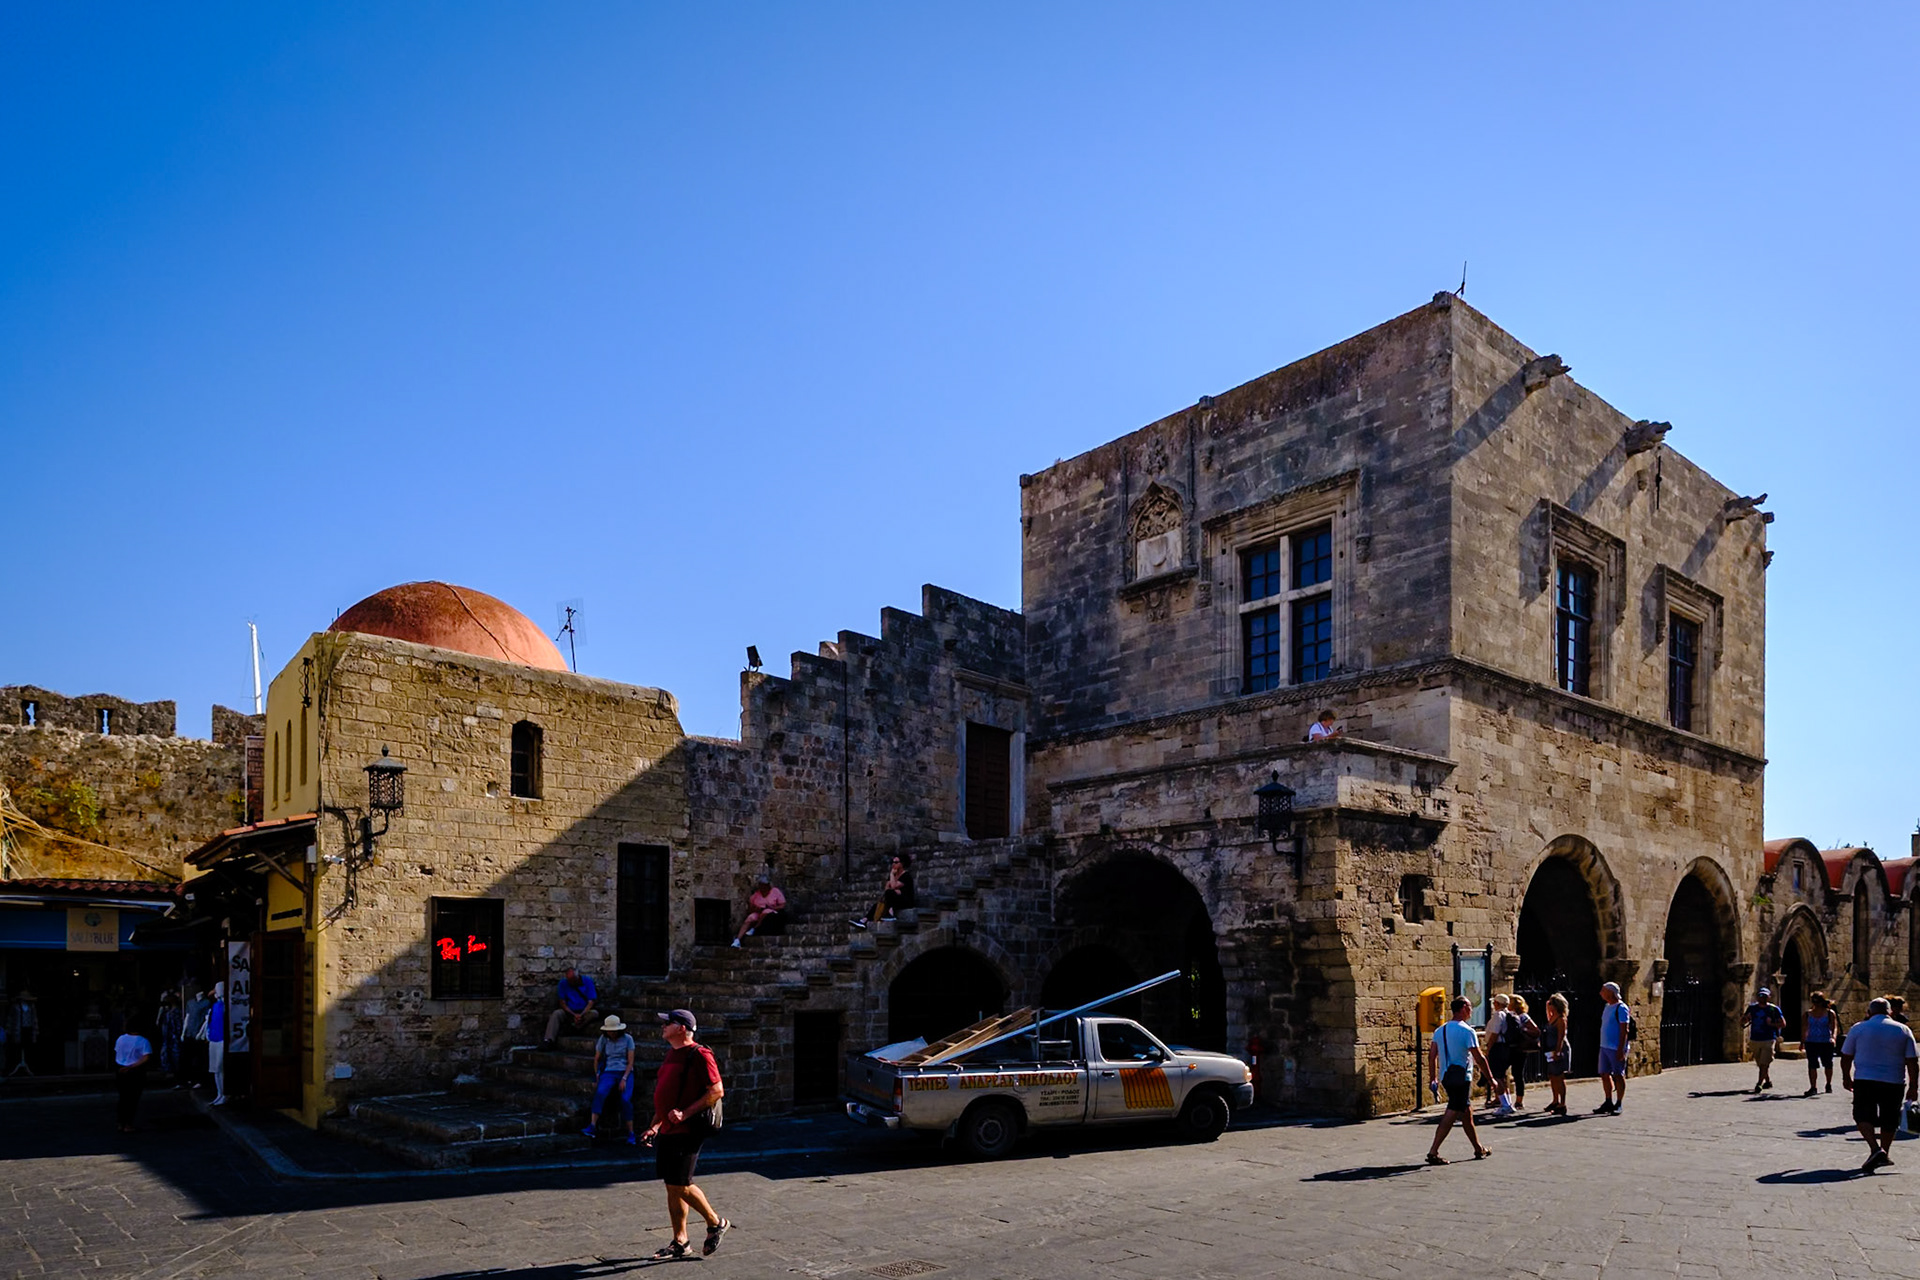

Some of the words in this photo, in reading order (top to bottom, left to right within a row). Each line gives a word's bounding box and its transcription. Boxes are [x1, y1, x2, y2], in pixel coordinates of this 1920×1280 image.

[908, 1077, 949, 1091] ΤΕΝΤΕΣ
[960, 1074, 1014, 1089] ΑΝΔΡΕΑΣ
[1018, 1072, 1078, 1086] ΝΙΚΟΛΑΟΥ
